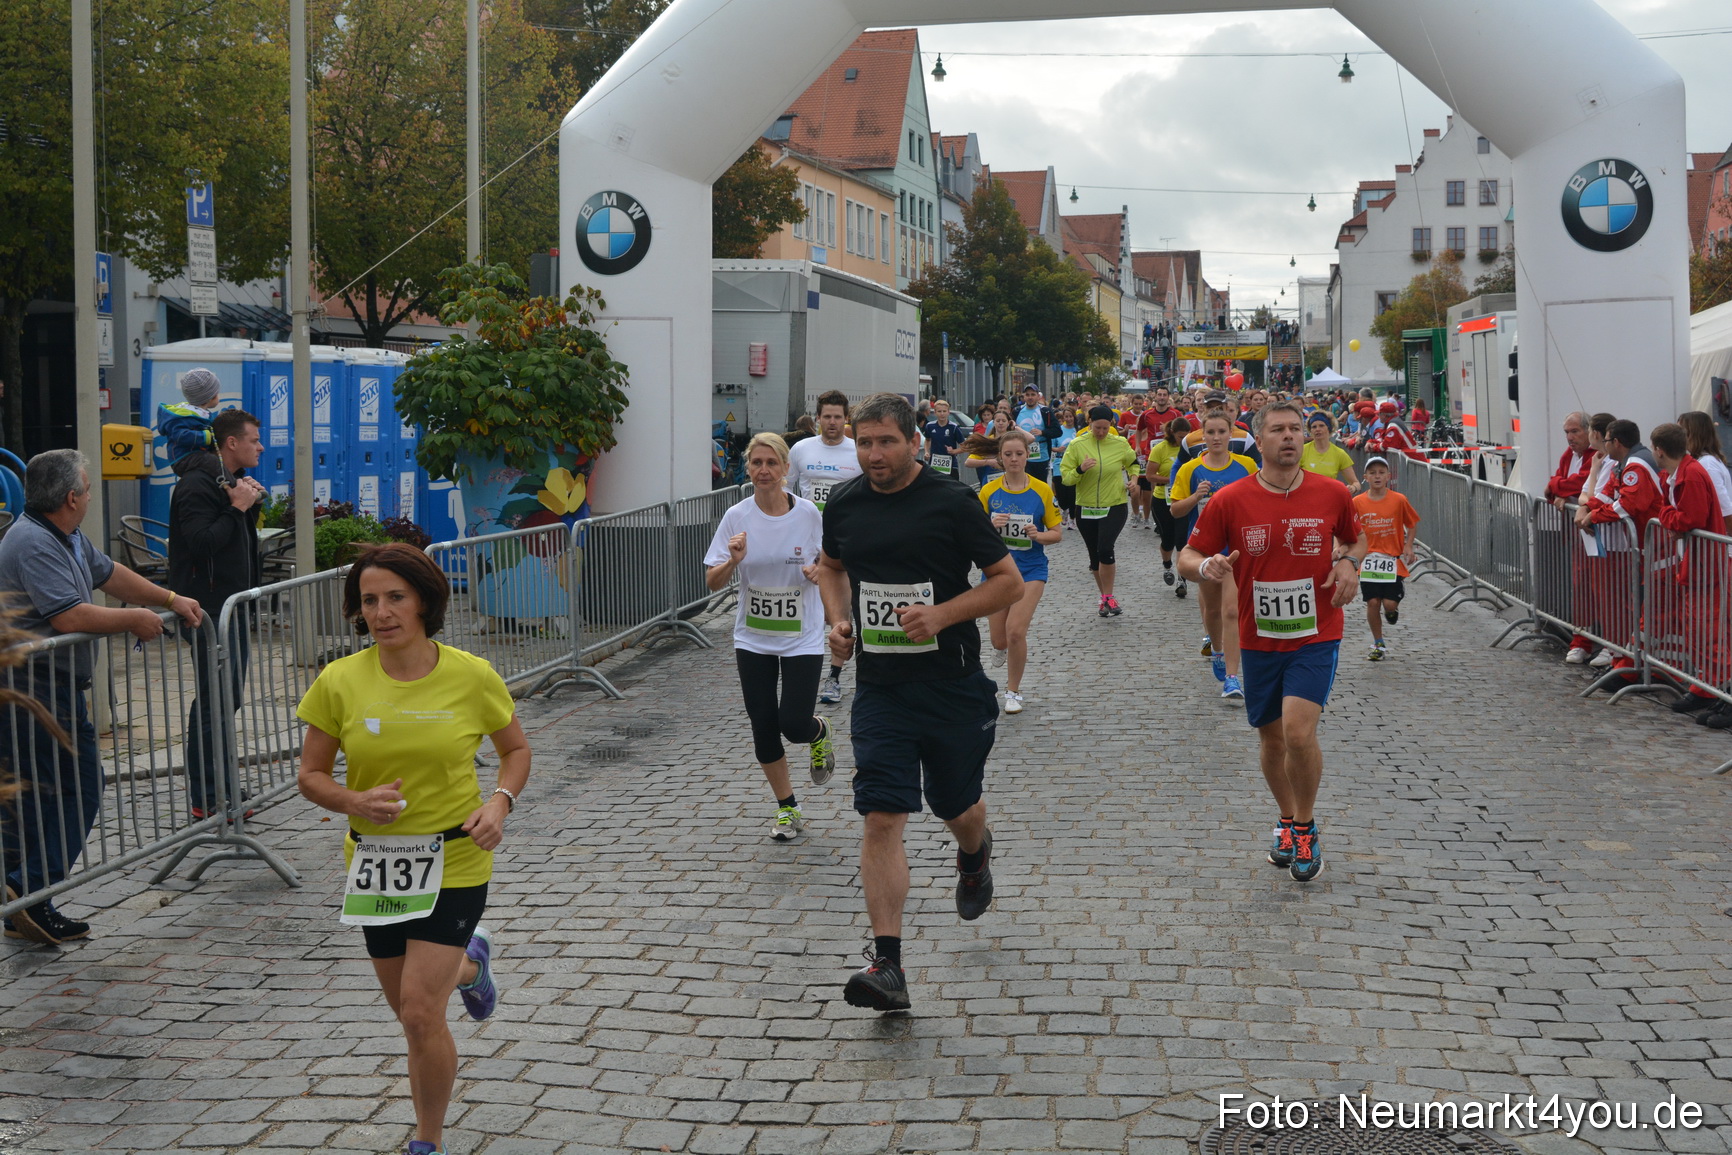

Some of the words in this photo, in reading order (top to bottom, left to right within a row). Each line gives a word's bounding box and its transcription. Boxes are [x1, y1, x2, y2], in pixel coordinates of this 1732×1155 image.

[1569, 160, 1647, 193] BMW
[580, 192, 646, 220] BMW
[133, 338, 141, 357] 3
[1206, 348, 1238, 357] START
[932, 458, 950, 467] 5528
[1247, 539, 1265, 547] NEU
[1364, 559, 1394, 572] 5148
[747, 587, 764, 596] PARTL
[861, 588, 882, 597] PARTL
[1254, 585, 1272, 594] PARTL
[1273, 586, 1304, 594] Neumarkt
[750, 596, 797, 618] 5515
[1259, 593, 1310, 617] 5116
[866, 600, 926, 628] 52
[1270, 621, 1301, 631] Thomas
[877, 633, 915, 644] Andrea
[356, 844, 378, 853] PARTL
[379, 844, 426, 853] Neumarkt
[355, 857, 435, 892] 5137
[375, 899, 408, 913] Hilde
